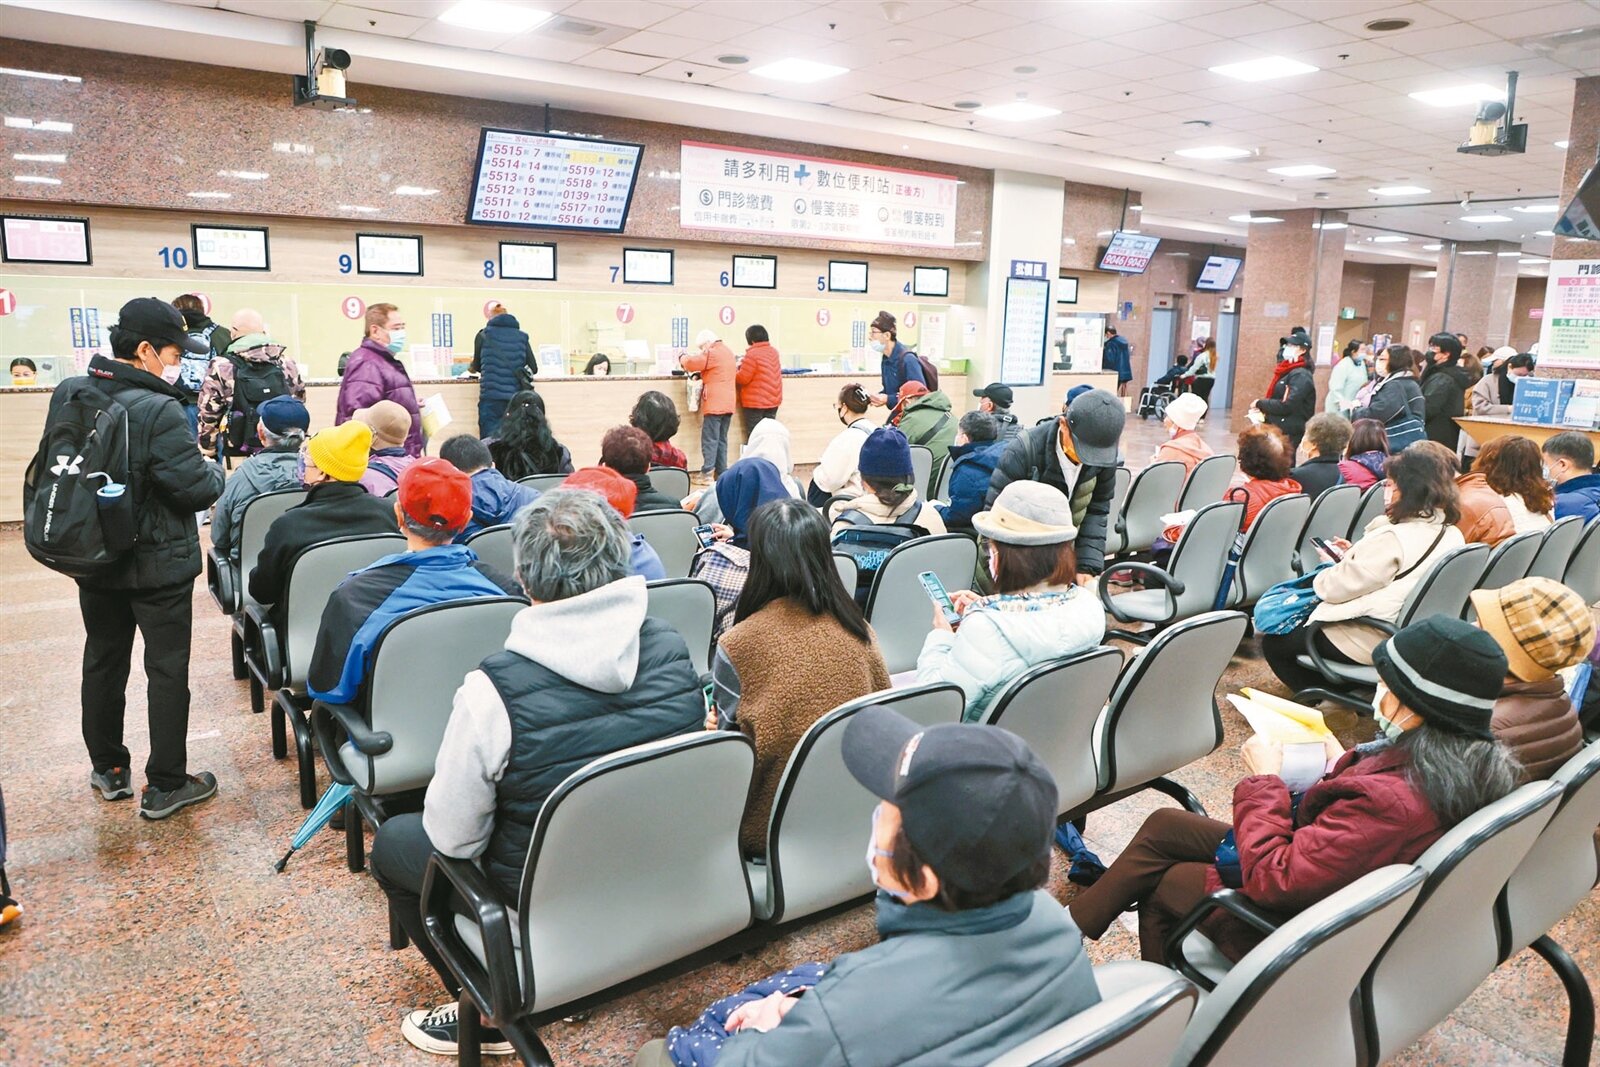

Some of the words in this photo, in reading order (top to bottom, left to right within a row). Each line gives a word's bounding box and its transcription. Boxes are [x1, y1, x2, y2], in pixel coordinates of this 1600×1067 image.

[494, 144, 524, 156] 5515
[534, 148, 540, 158] 7
[491, 157, 520, 170] 5514
[528, 162, 541, 171] 14
[568, 164, 595, 176] 5519
[602, 168, 614, 178] 12
[724, 158, 790, 184] 請多利用
[488, 170, 517, 182] 5513
[528, 175, 535, 183] 6
[566, 178, 592, 189] 5518
[602, 181, 608, 189] 9
[817, 170, 890, 195] 數位便利站
[486, 184, 515, 195] 5512
[523, 187, 536, 196] 13
[563, 190, 590, 201] 0139
[597, 193, 608, 202] 13
[484, 196, 512, 207] 5511
[523, 200, 530, 208] 6
[560, 202, 587, 213] 5517
[594, 205, 605, 214] 10
[718, 190, 773, 212] 門診繳費
[481, 209, 510, 220] 5510
[518, 212, 530, 221] 12
[812, 200, 860, 218] 慢箋領藥
[558, 214, 584, 225] 5516
[593, 217, 600, 225] 6
[158, 246, 188, 269] 10
[338, 253, 353, 275] 9
[1105, 255, 1125, 265] 9046
[1127, 258, 1146, 268] 9043
[484, 260, 495, 279] 8
[609, 266, 620, 283] 7
[720, 271, 729, 287] 6
[817, 276, 826, 292] 5
[903, 281, 911, 296] 4
[346, 297, 360, 318] 9
[620, 305, 629, 321] 7
[723, 307, 732, 324] 6
[819, 310, 828, 325] 5
[905, 312, 914, 327] 4
[48, 484, 58, 508] UNDER
